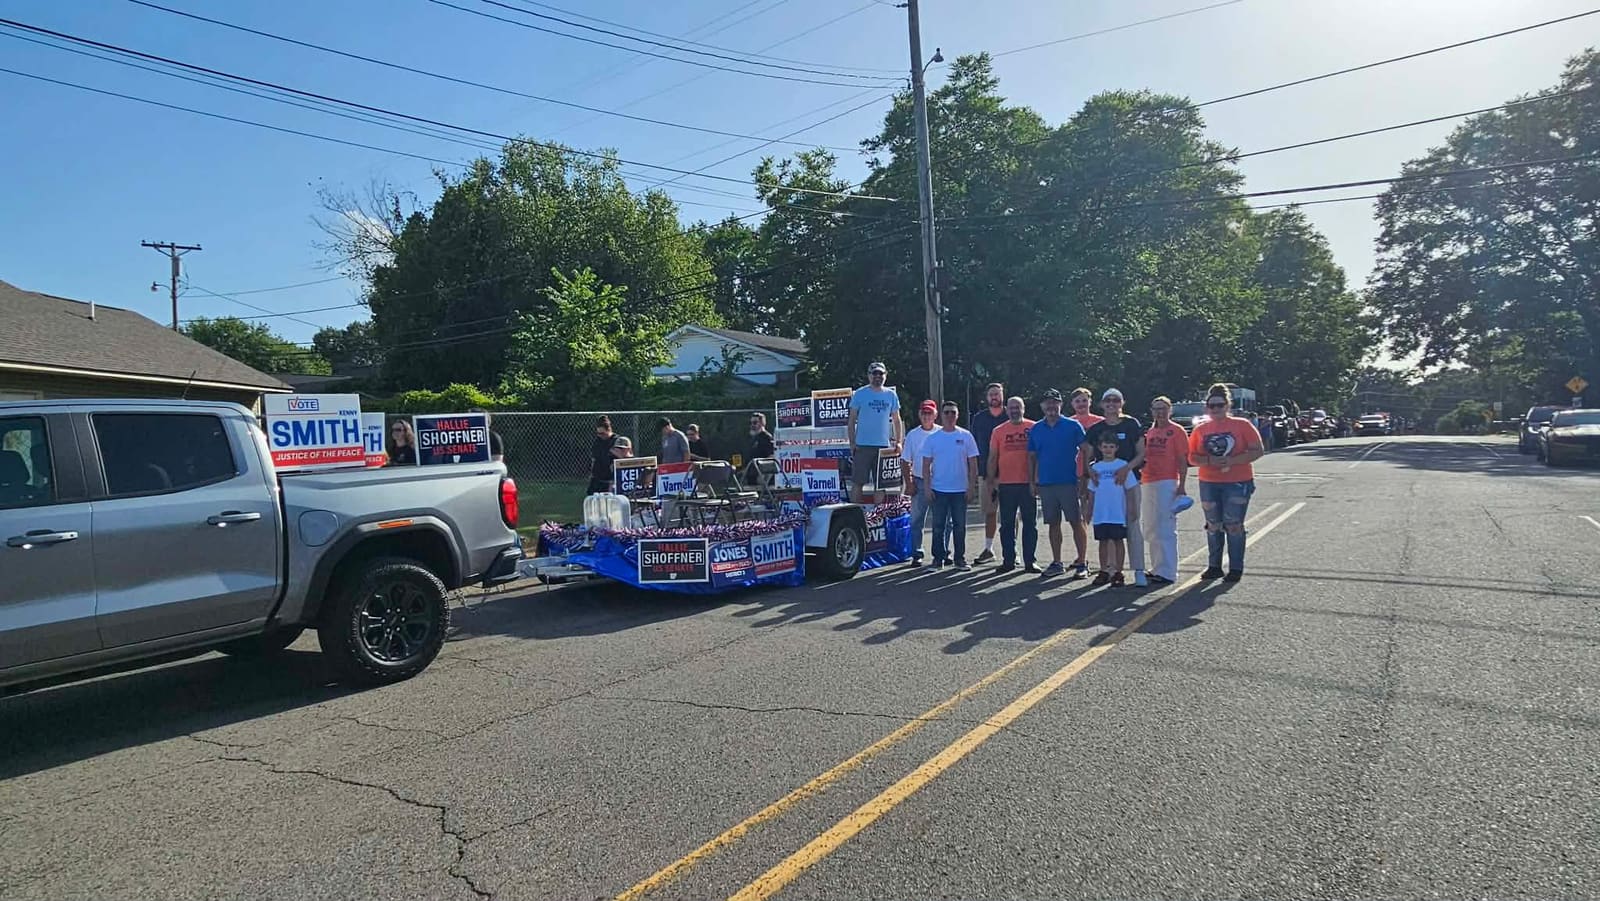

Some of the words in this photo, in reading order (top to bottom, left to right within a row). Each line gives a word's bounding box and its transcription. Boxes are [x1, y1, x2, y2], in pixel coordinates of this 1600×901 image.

[290, 398, 318, 409] VOTE
[819, 398, 848, 410] KELLY
[778, 407, 810, 417] SHOFFNER
[819, 409, 849, 419] GRAPPE
[436, 419, 469, 430] HALLIE
[272, 419, 360, 447] SMITH
[422, 430, 484, 446] SHOFFNER
[276, 451, 308, 461] JUSTICE
[309, 451, 322, 459] OF
[322, 449, 336, 458] THE
[337, 448, 361, 457] PEACE
[447, 444, 477, 455] SENATE
[882, 457, 901, 470] KELL
[663, 478, 693, 492] Varnell
[807, 476, 836, 489] Varnell
[644, 552, 703, 564] SHOFFNER
[713, 546, 748, 562] JONES
[754, 540, 793, 563] SMITH
